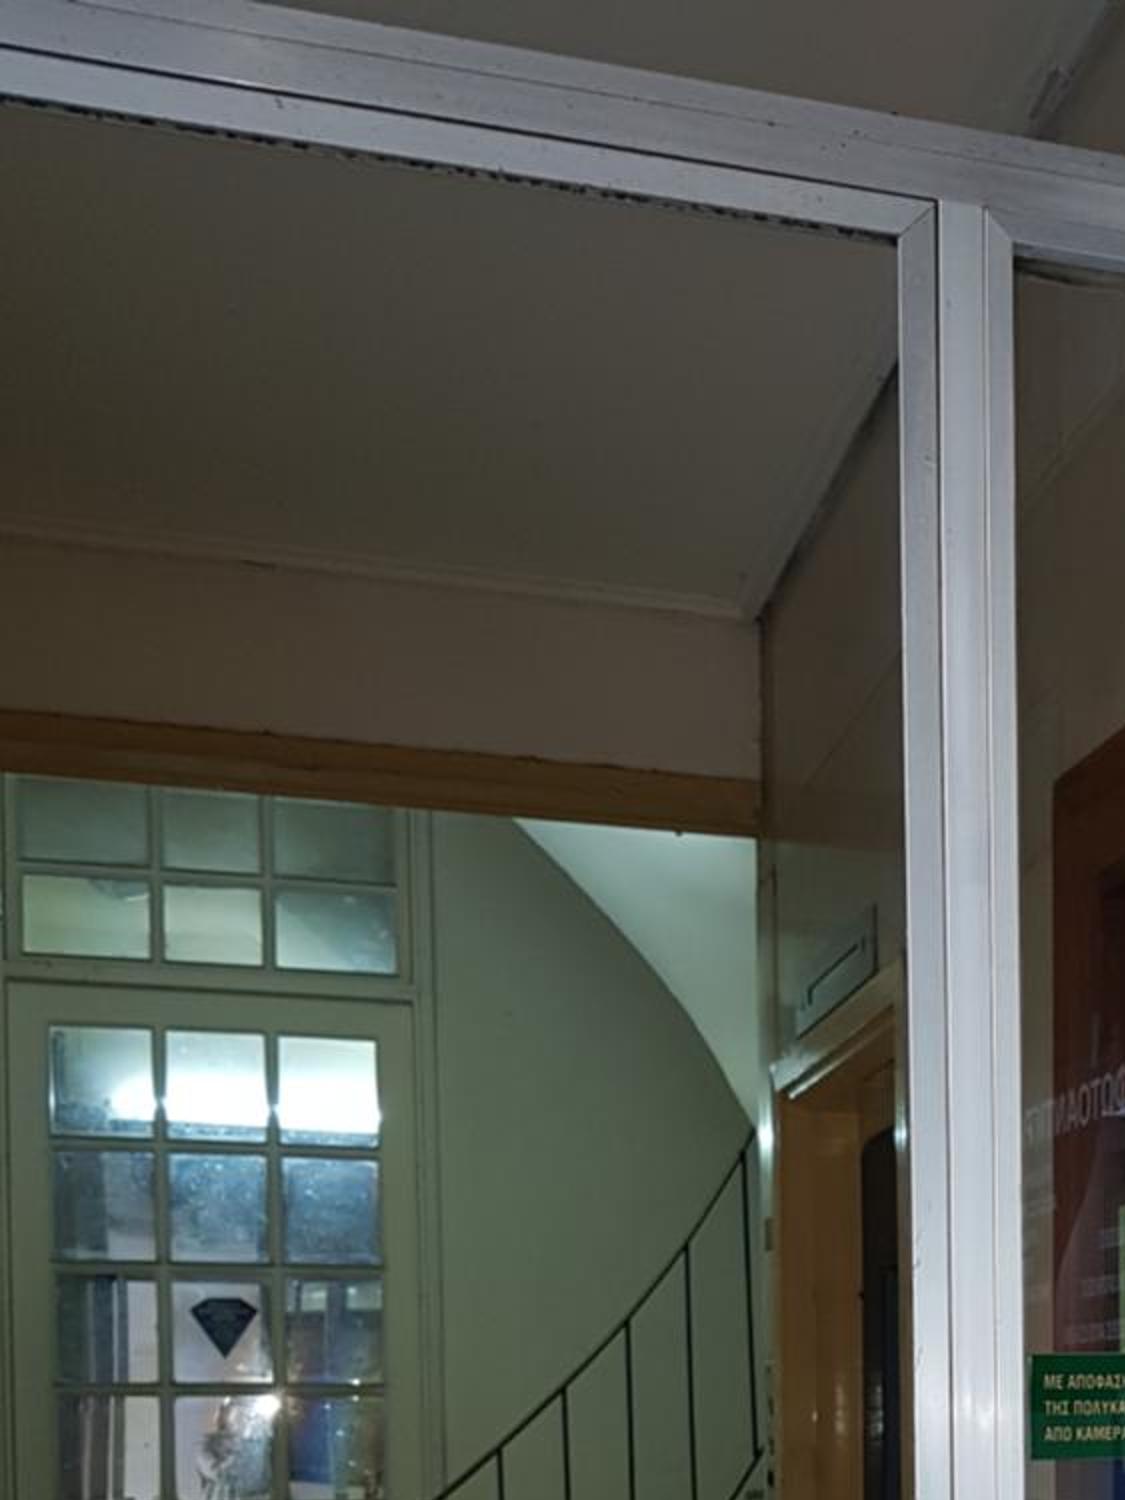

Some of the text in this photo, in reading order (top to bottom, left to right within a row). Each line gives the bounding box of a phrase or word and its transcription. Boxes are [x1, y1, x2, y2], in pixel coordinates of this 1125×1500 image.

[1043, 1373, 1063, 1389] ΜΕ
[1044, 1401, 1071, 1416] ΤΗΣ
[1043, 1426, 1072, 1442] ΑΠΟ
